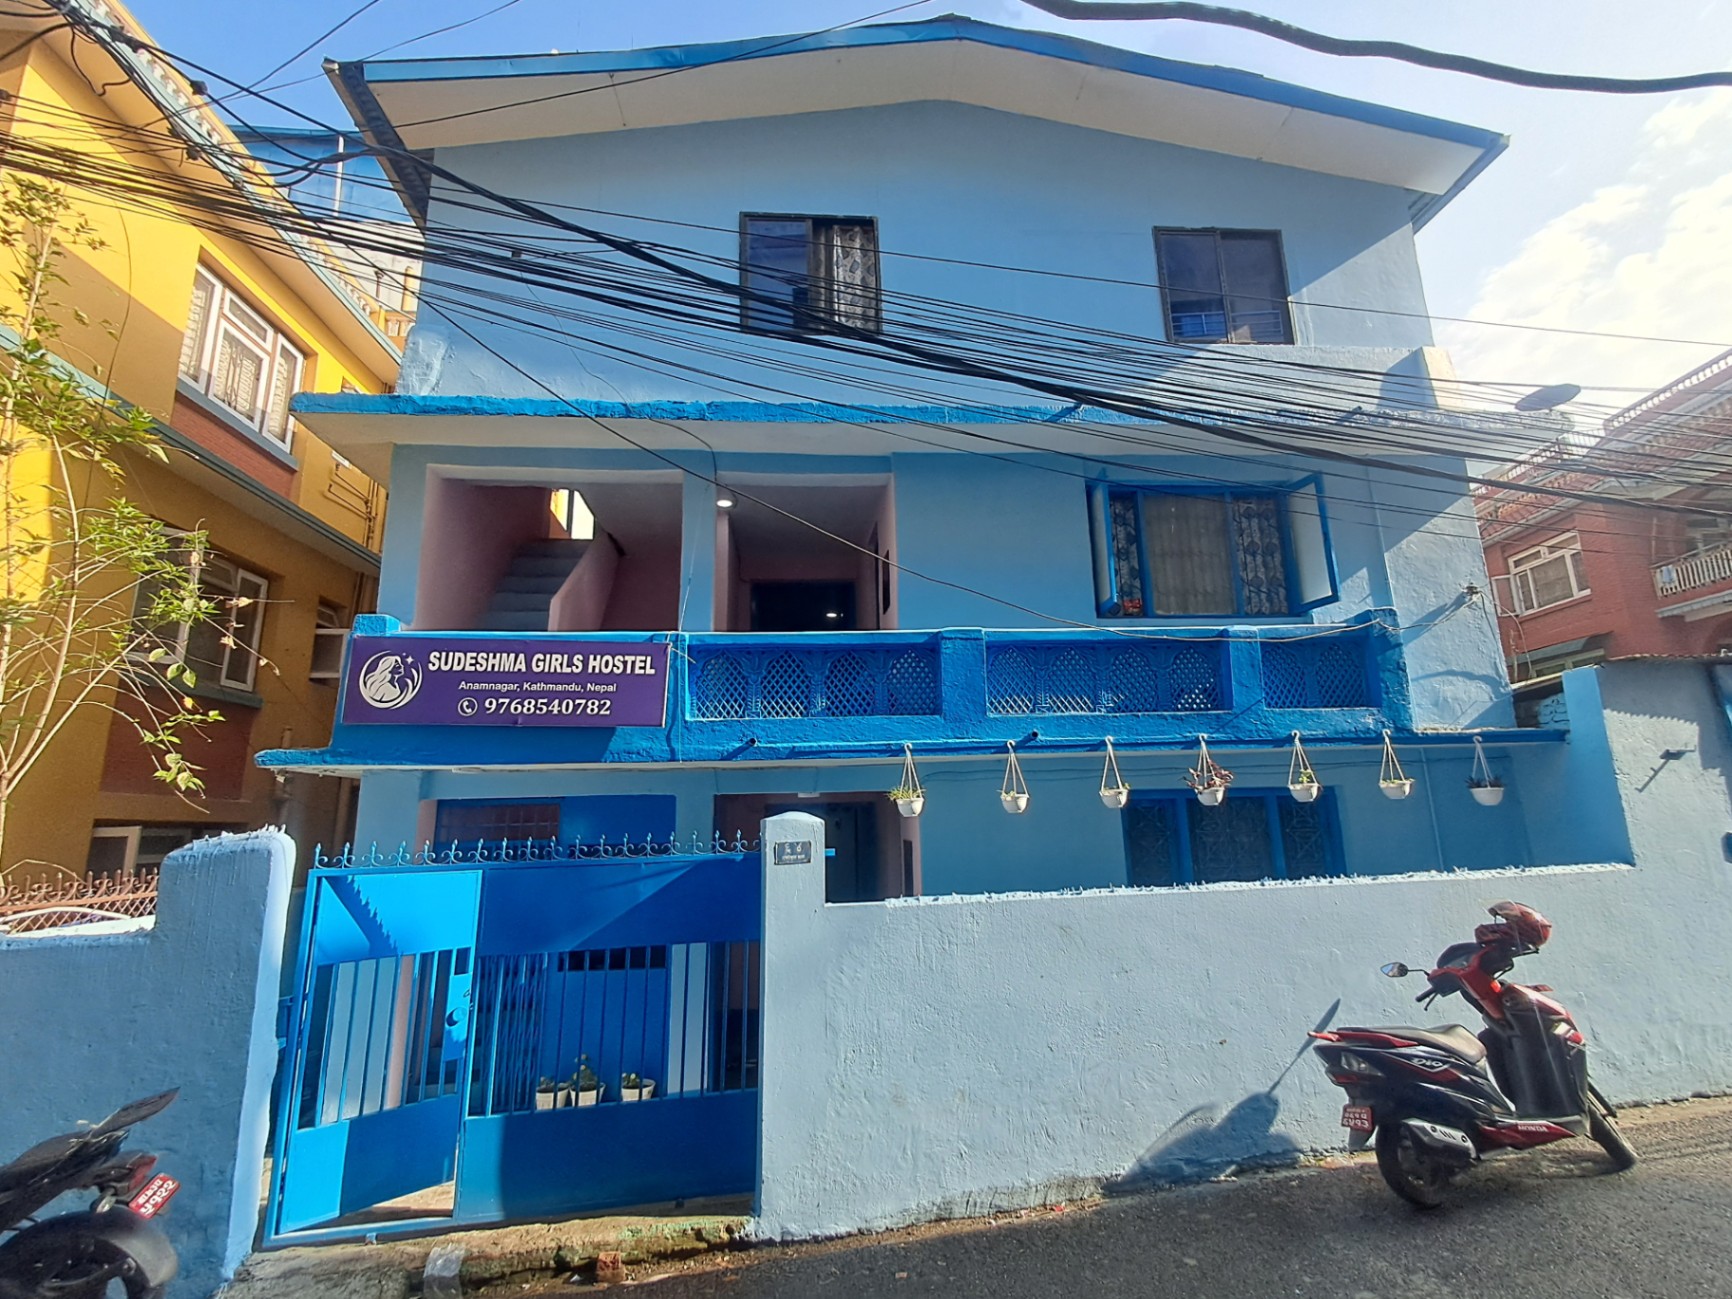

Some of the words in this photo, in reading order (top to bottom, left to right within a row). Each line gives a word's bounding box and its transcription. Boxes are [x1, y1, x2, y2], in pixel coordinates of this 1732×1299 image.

[428, 651, 527, 673] SUDESHMA
[531, 653, 584, 673] GIRLS
[588, 655, 656, 675] HOSTEL
[458, 681, 520, 692] Anamnagar,
[523, 682, 584, 693] Kathmandu,
[587, 683, 617, 693] Nepal
[484, 698, 611, 715] 9768540782
[1518, 1125, 1549, 1133] HONDA
